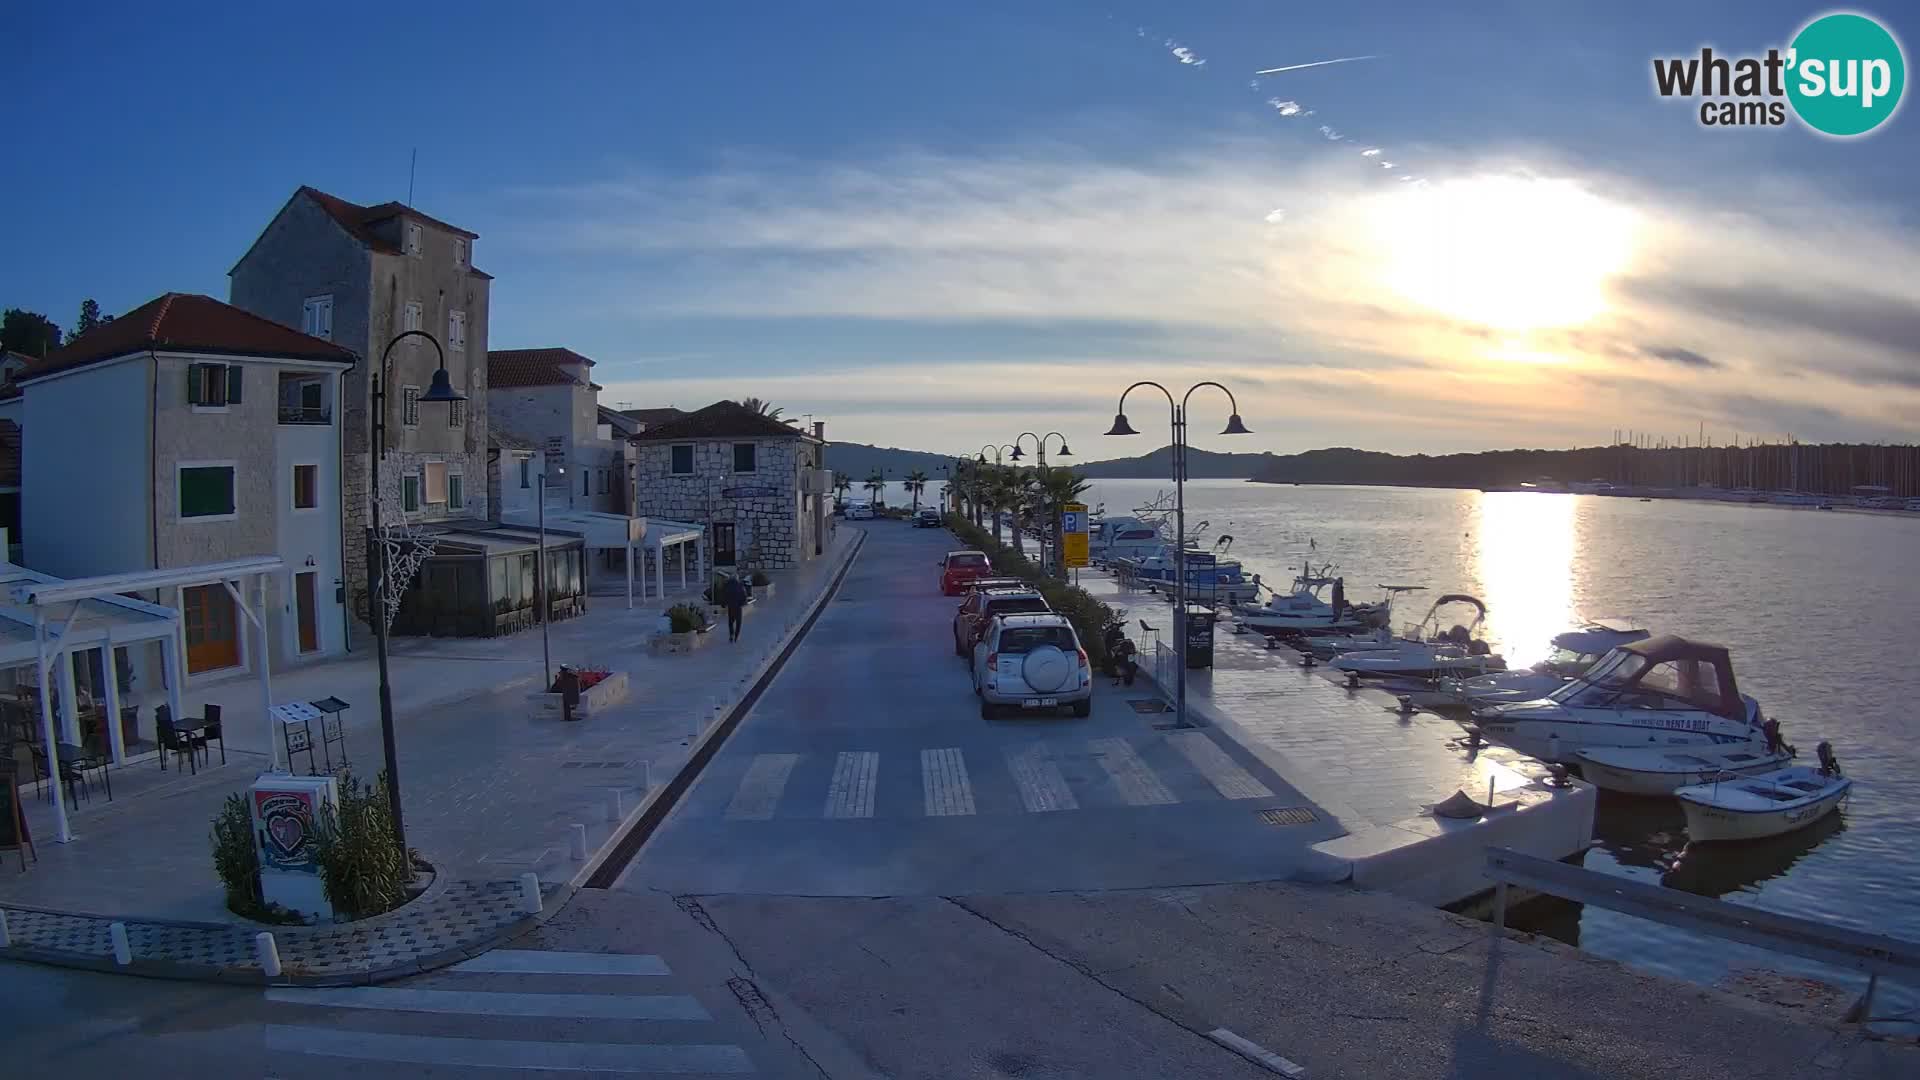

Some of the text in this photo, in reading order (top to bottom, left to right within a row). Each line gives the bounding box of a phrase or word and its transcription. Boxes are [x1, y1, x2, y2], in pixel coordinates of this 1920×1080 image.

[1065, 514, 1075, 530] P
[1666, 719, 1684, 729] RENT
[1692, 720, 1711, 731] BOAT
